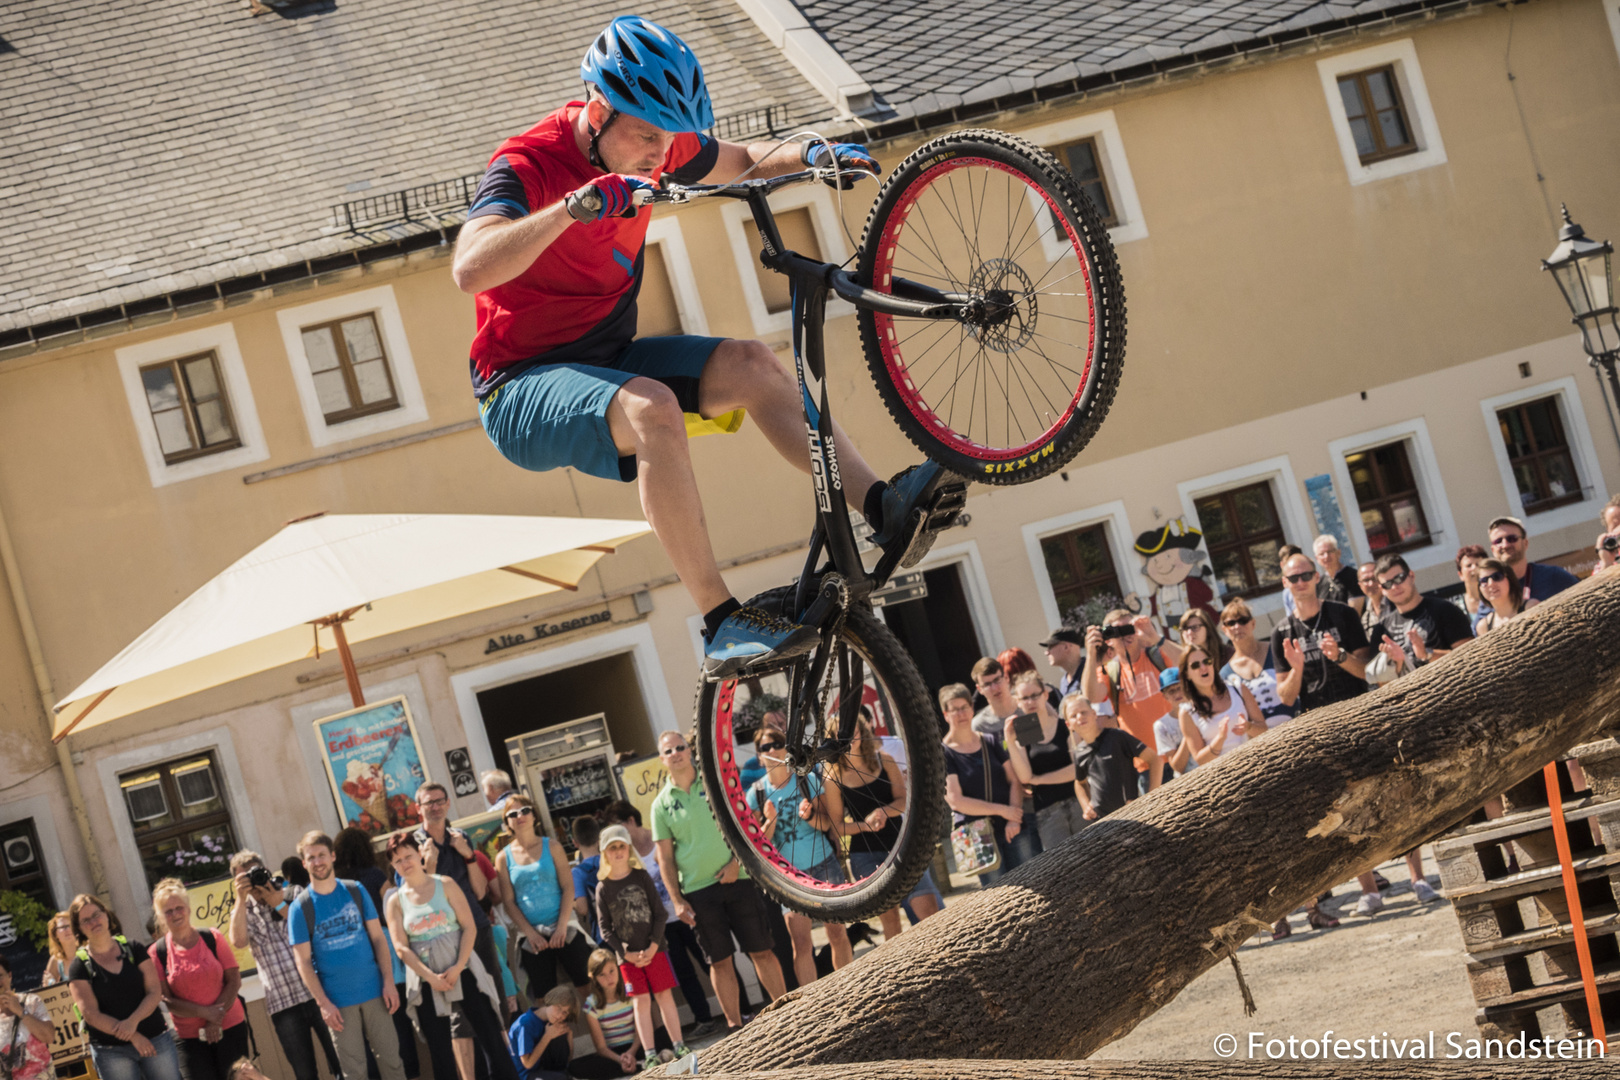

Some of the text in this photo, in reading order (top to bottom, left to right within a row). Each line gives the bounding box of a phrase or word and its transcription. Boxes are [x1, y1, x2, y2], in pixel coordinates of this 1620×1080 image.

[805, 422, 832, 513] SCOTT
[985, 441, 1055, 474] MAXXIS
[484, 609, 612, 655] Alte Kaserne
[328, 724, 404, 754] Erdbeeren
